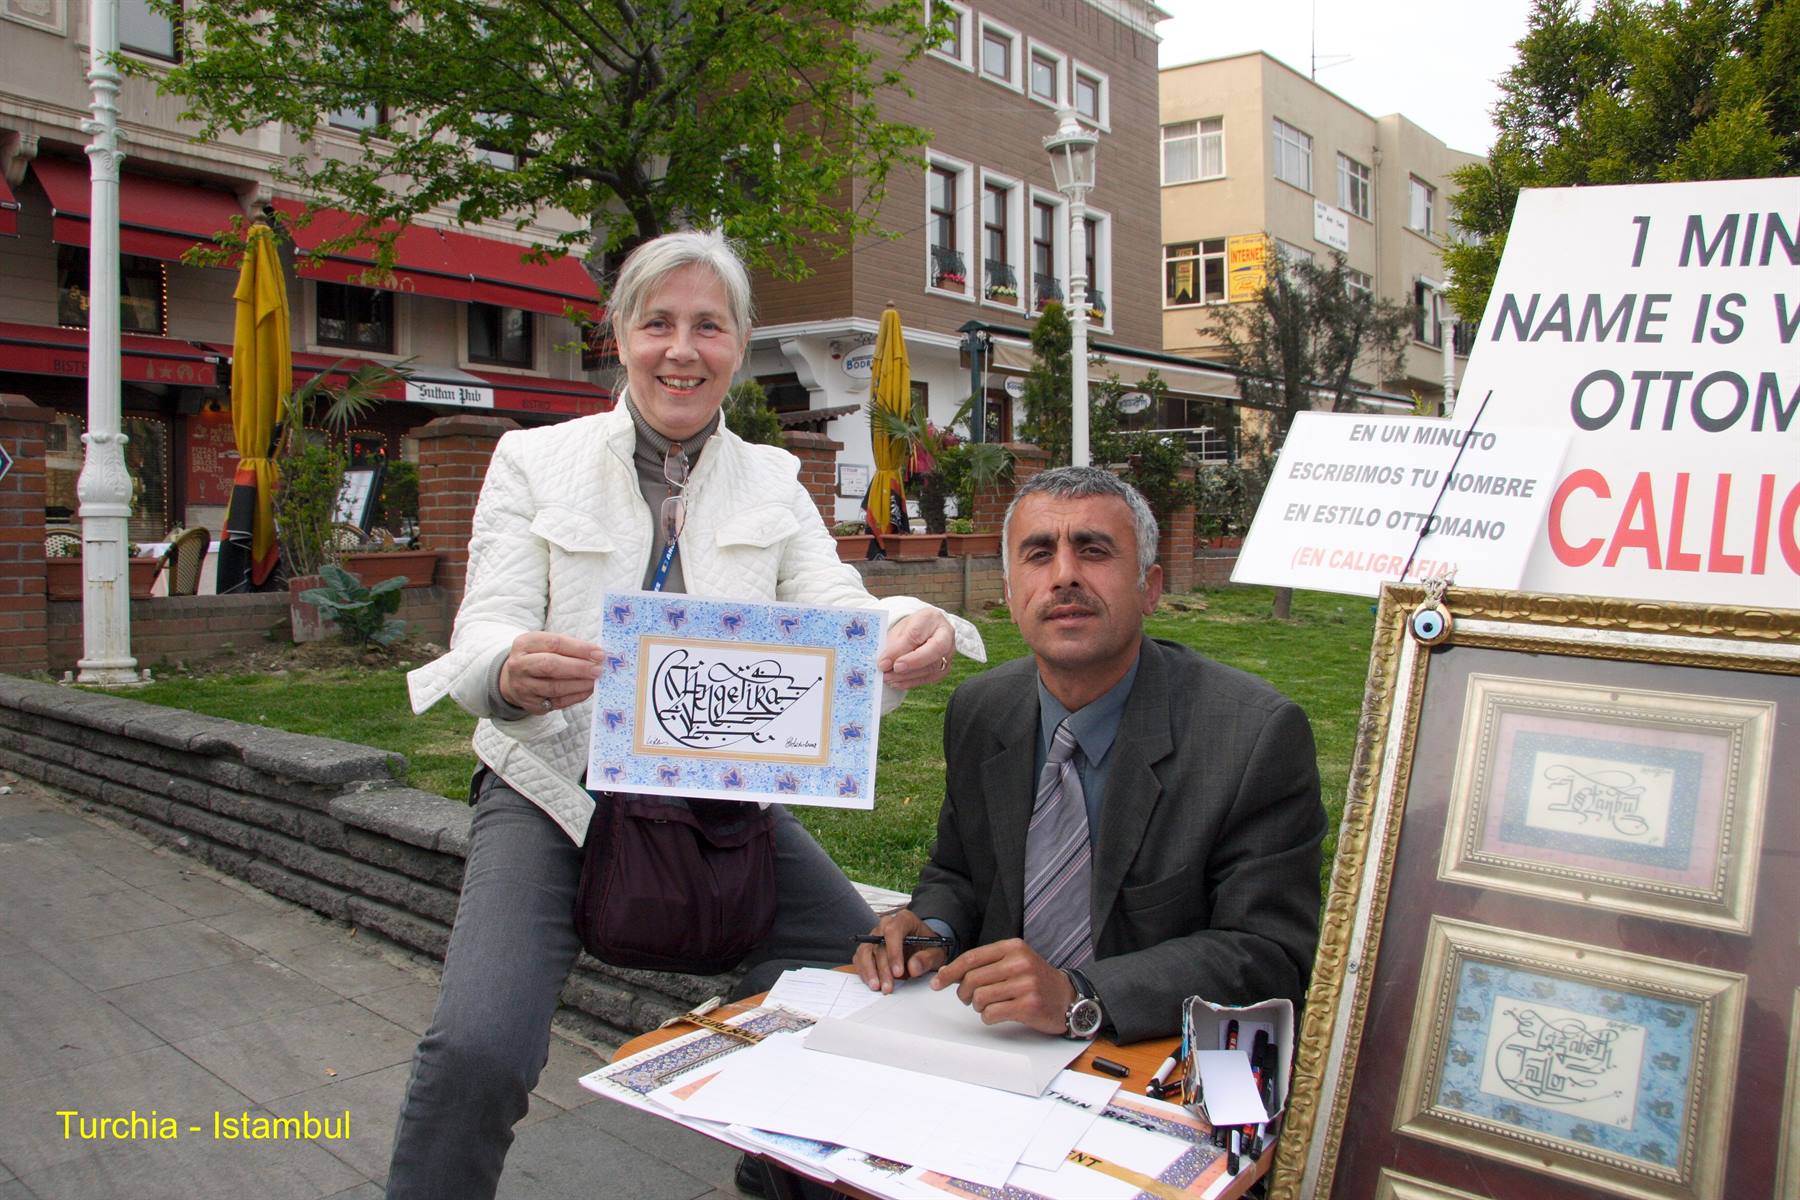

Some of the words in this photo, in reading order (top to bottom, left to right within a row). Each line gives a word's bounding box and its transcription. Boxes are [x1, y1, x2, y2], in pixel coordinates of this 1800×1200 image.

[1230, 246, 1265, 265] INTERNET
[1631, 215, 1652, 268] 1
[1677, 212, 1800, 268] MIN
[1490, 292, 1673, 343] NAME
[1691, 292, 1748, 345] IS
[419, 384, 455, 401] Sultan
[459, 387, 481, 404] Pub
[1570, 369, 1800, 433] OTTOM
[1349, 423, 1377, 442] EN
[1380, 425, 1410, 443] UN
[1413, 426, 1497, 451] MINUTO
[1288, 461, 1404, 486] ESCRIBIMOS
[1411, 467, 1440, 489] TU
[1446, 471, 1537, 498] NOMBRE
[1283, 502, 1311, 522] EN
[1312, 504, 1381, 527] ESTILO
[1385, 509, 1505, 541] OTTOMANO
[1290, 546, 1326, 570] (EN
